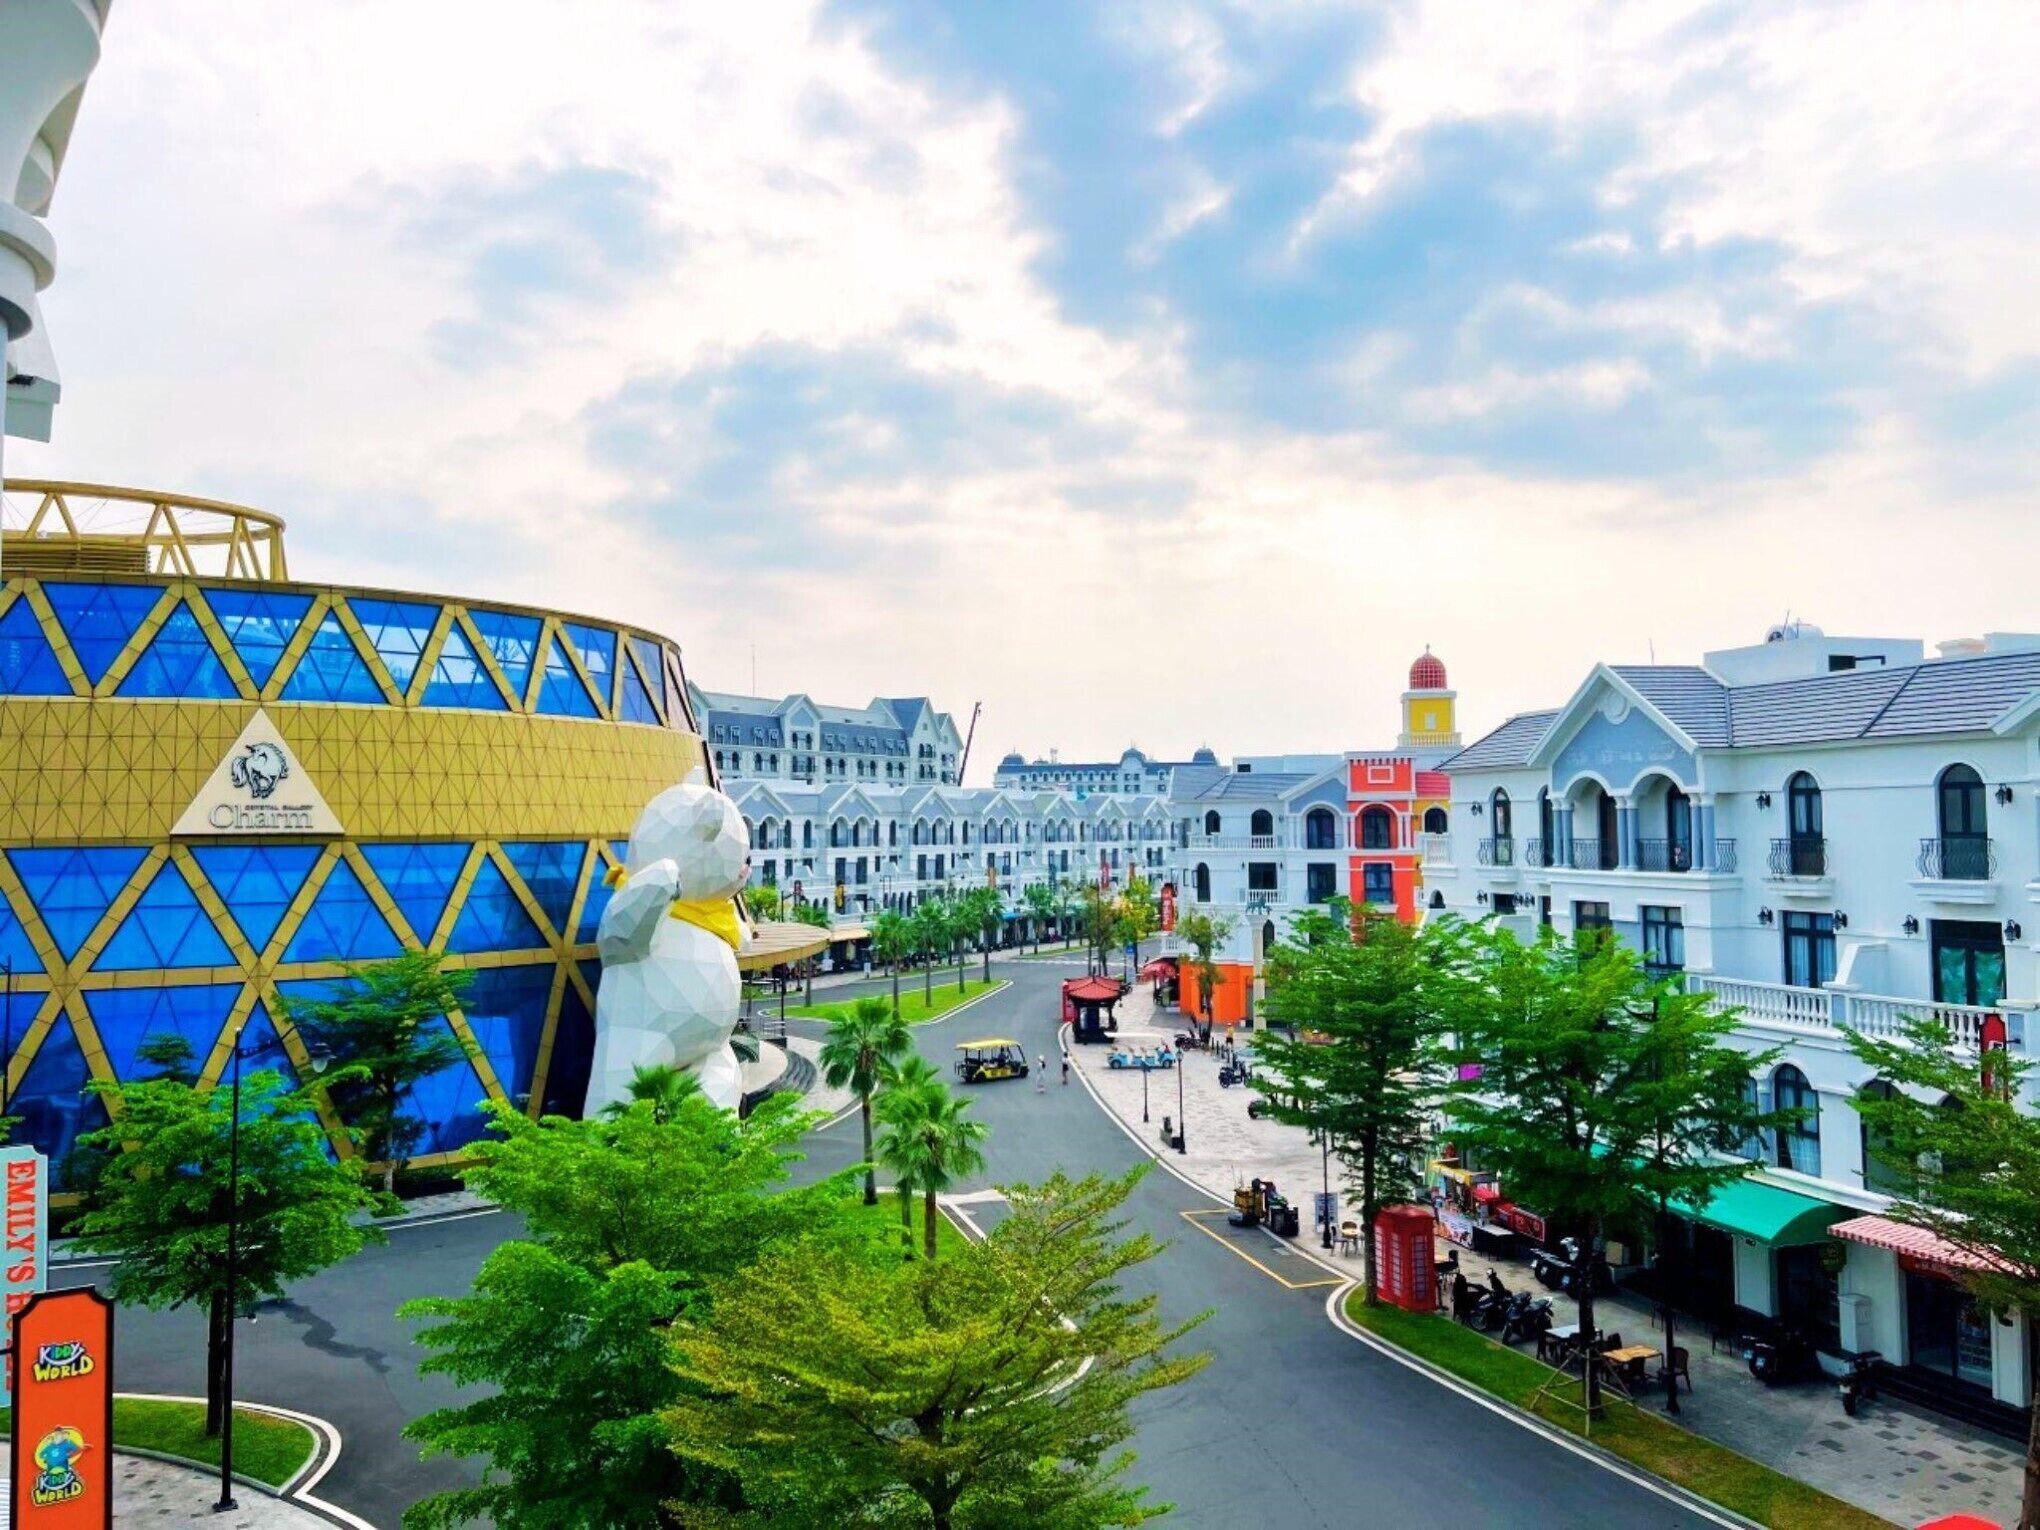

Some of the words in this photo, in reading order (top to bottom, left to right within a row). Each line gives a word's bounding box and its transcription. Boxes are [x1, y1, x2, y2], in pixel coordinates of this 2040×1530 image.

[208, 804, 313, 829] Charm
[6, 1159, 36, 1283] EMILY'S
[33, 1354, 94, 1382] WORLD
[35, 1481, 82, 1503] WORLD
